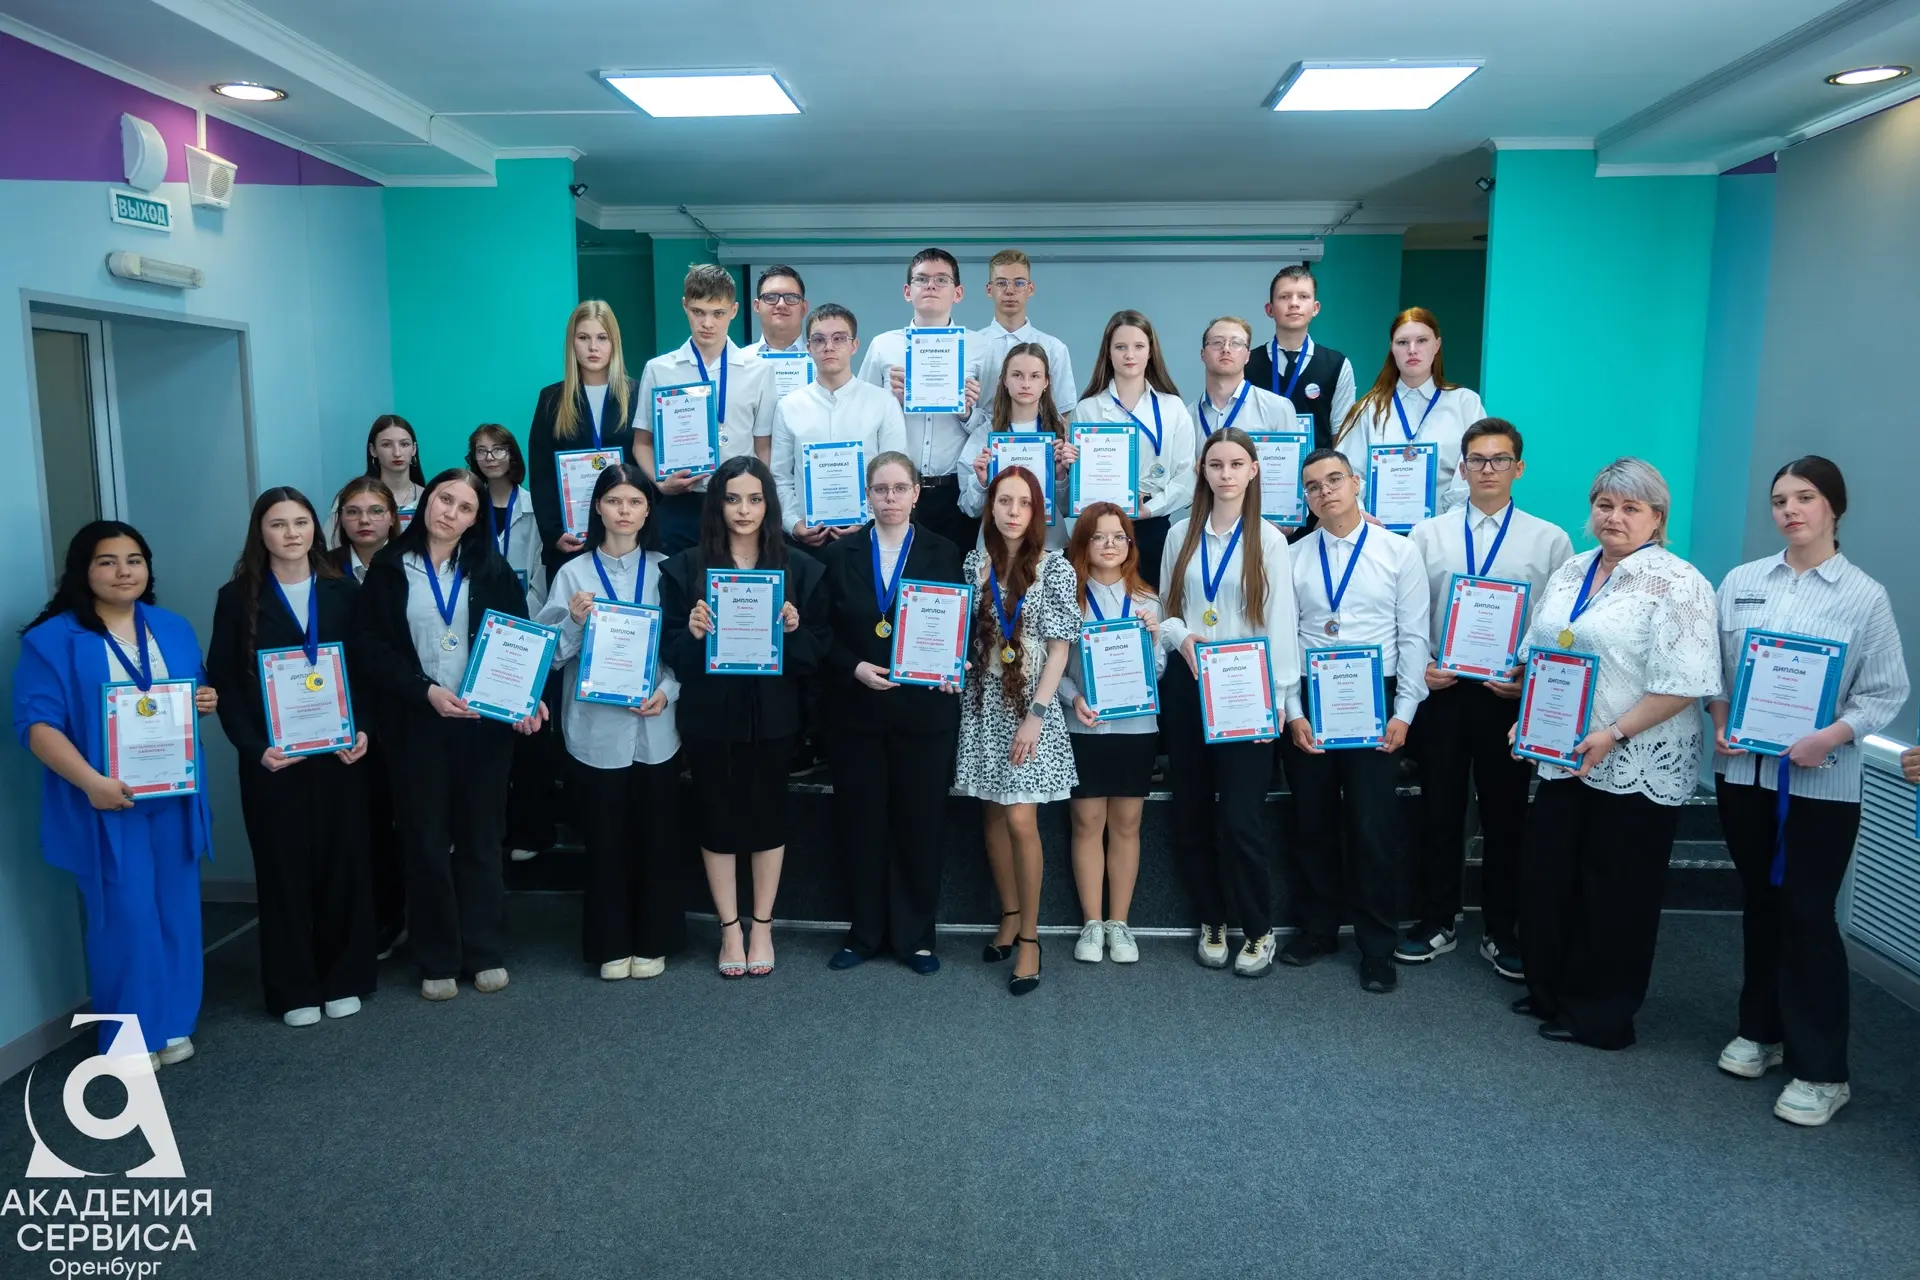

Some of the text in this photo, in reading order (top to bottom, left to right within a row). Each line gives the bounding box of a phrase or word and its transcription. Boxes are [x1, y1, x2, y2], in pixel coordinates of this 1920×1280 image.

[117, 198, 168, 226] ВЫХОД
[1473, 602, 1500, 610] ДИПЛОМ
[609, 627, 636, 635] ДИПЛОМ
[502, 641, 529, 652] ДИПЛОМ
[1104, 644, 1129, 652] ДИПЛОМ
[1772, 665, 1807, 676] ДИПЛОМ
[1547, 677, 1571, 686] ДИПЛОМ
